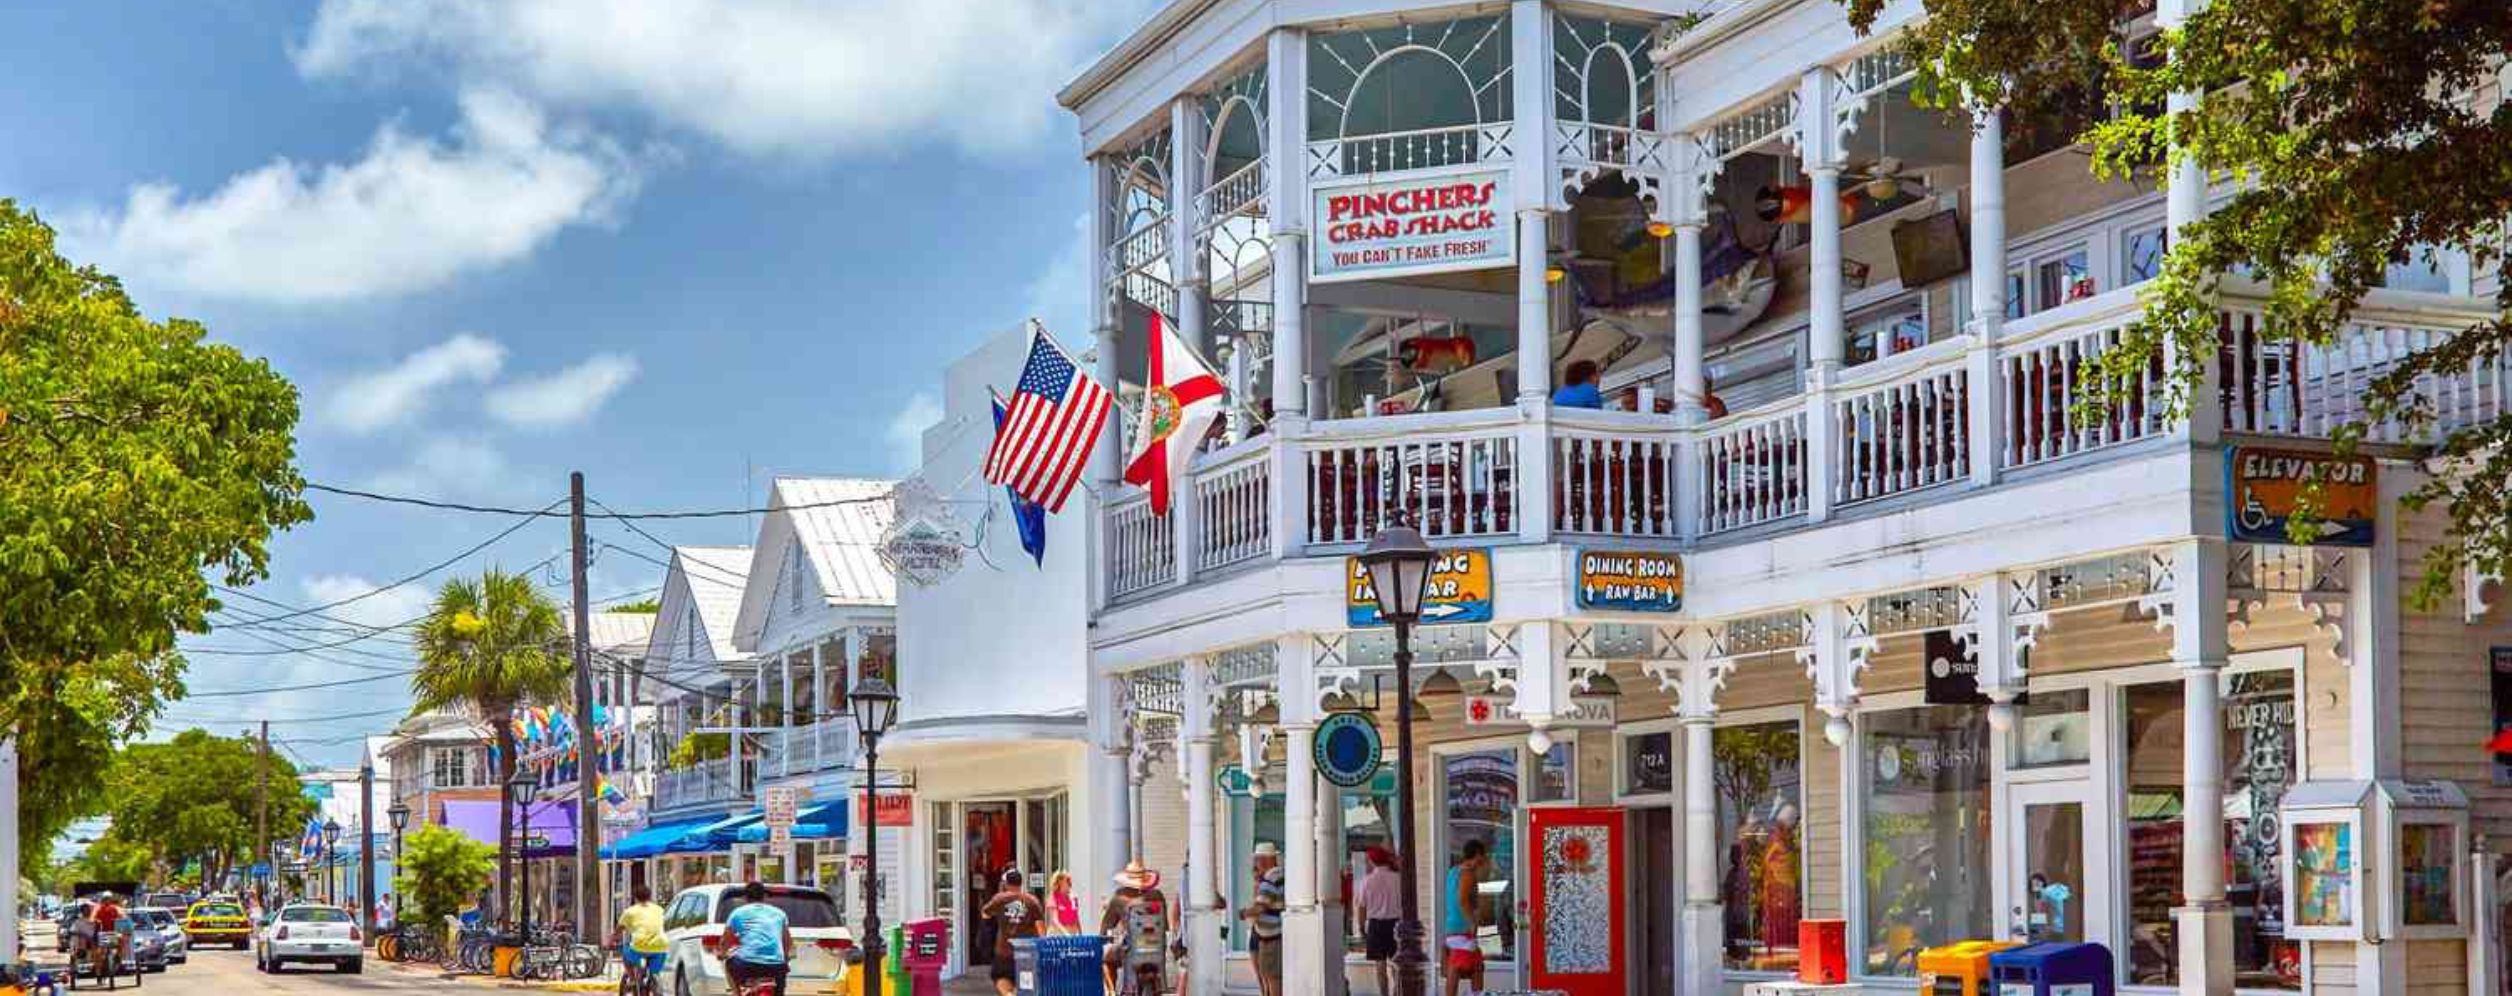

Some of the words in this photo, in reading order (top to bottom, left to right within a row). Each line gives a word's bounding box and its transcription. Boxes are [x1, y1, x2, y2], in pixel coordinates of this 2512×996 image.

[1328, 181, 1496, 222] PINCHERS
[1328, 218, 1400, 244] CRAB
[1404, 209, 1496, 235] SHACK
[1332, 251, 1359, 266] YOU
[1363, 247, 1401, 265] CAN'T
[1406, 245, 1441, 261] FAKE
[1444, 241, 1488, 257] FRESH
[2243, 454, 2365, 484] ELEVATOR
[1585, 556, 1633, 576] DINING
[1639, 558, 1676, 577] ROOM
[1605, 584, 1631, 600] RAW
[1634, 584, 1656, 601] BAR
[2226, 703, 2270, 730] NEVER
